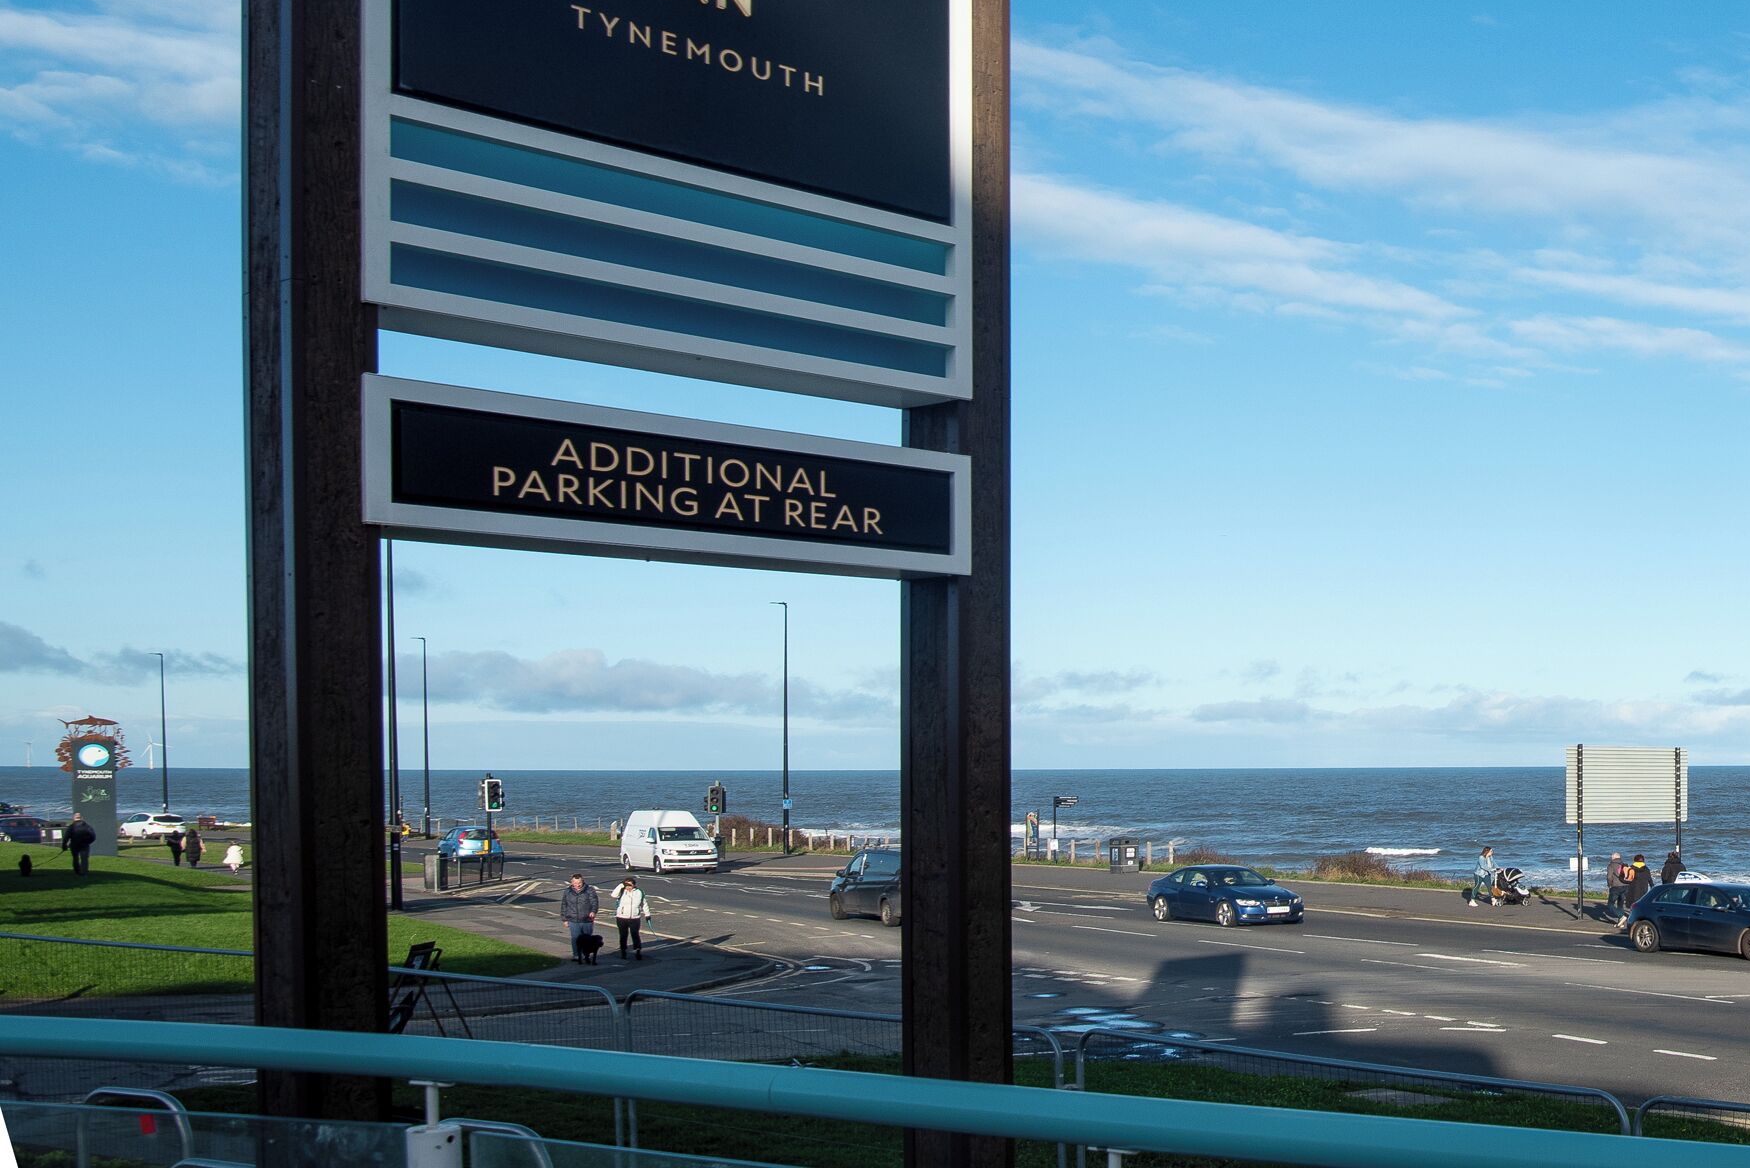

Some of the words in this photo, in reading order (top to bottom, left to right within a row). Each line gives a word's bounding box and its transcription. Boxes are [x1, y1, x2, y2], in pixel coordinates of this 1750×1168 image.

[570, 4, 823, 96] TYNEMOUTH
[493, 466, 698, 516] PARKING
[714, 493, 770, 523] AT
[785, 499, 883, 535] REAR
[551, 438, 836, 498] ADDITIONAL
